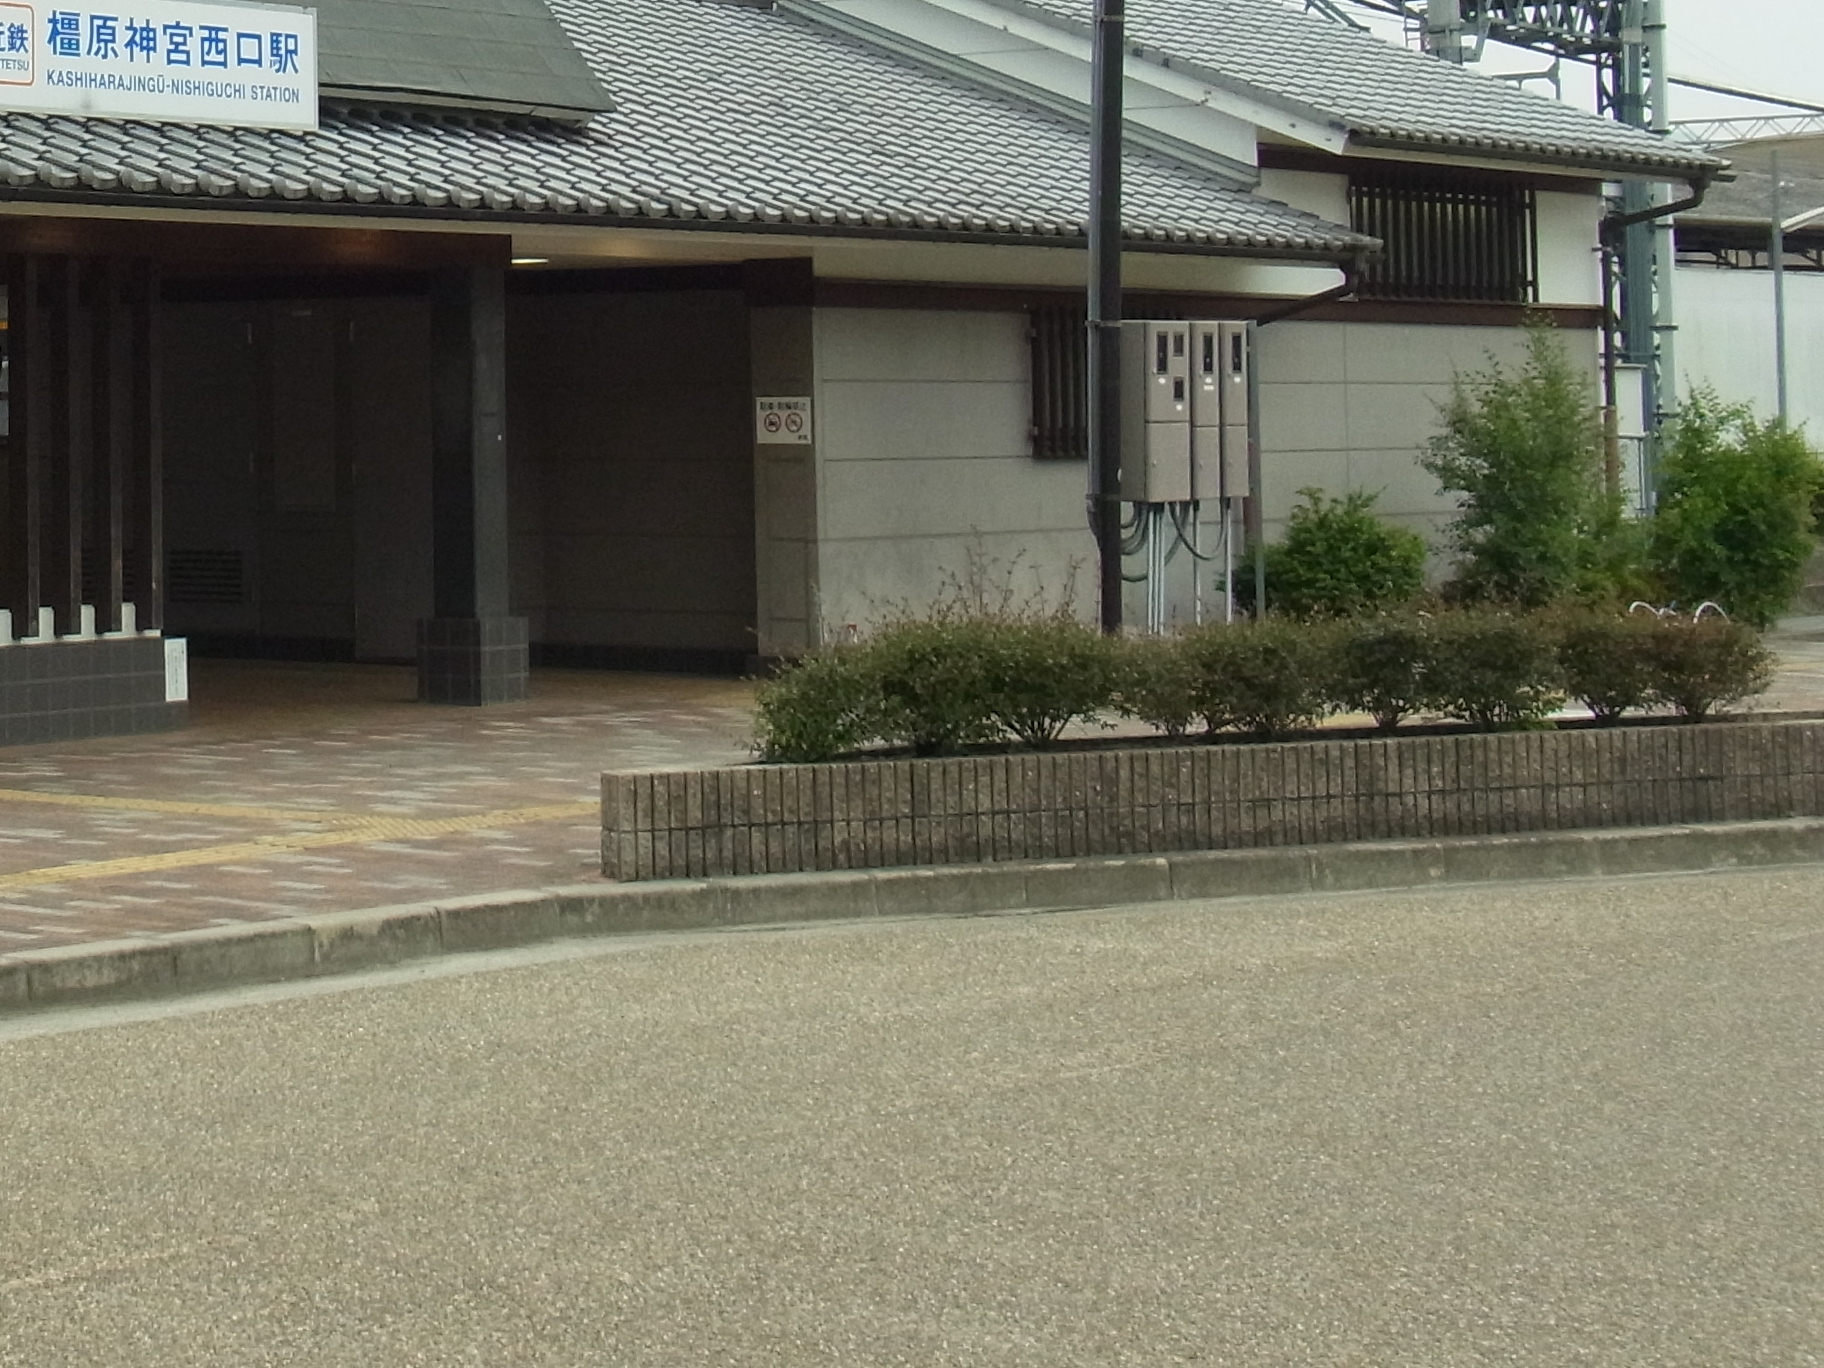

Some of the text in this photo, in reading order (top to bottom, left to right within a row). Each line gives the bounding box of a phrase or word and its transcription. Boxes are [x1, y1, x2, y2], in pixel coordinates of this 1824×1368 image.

[46, 9, 299, 74] 橿原神宮西口駅
[46, 69, 300, 104] KASHIHARAJINGŪ-NISHIGUCHI STATION
